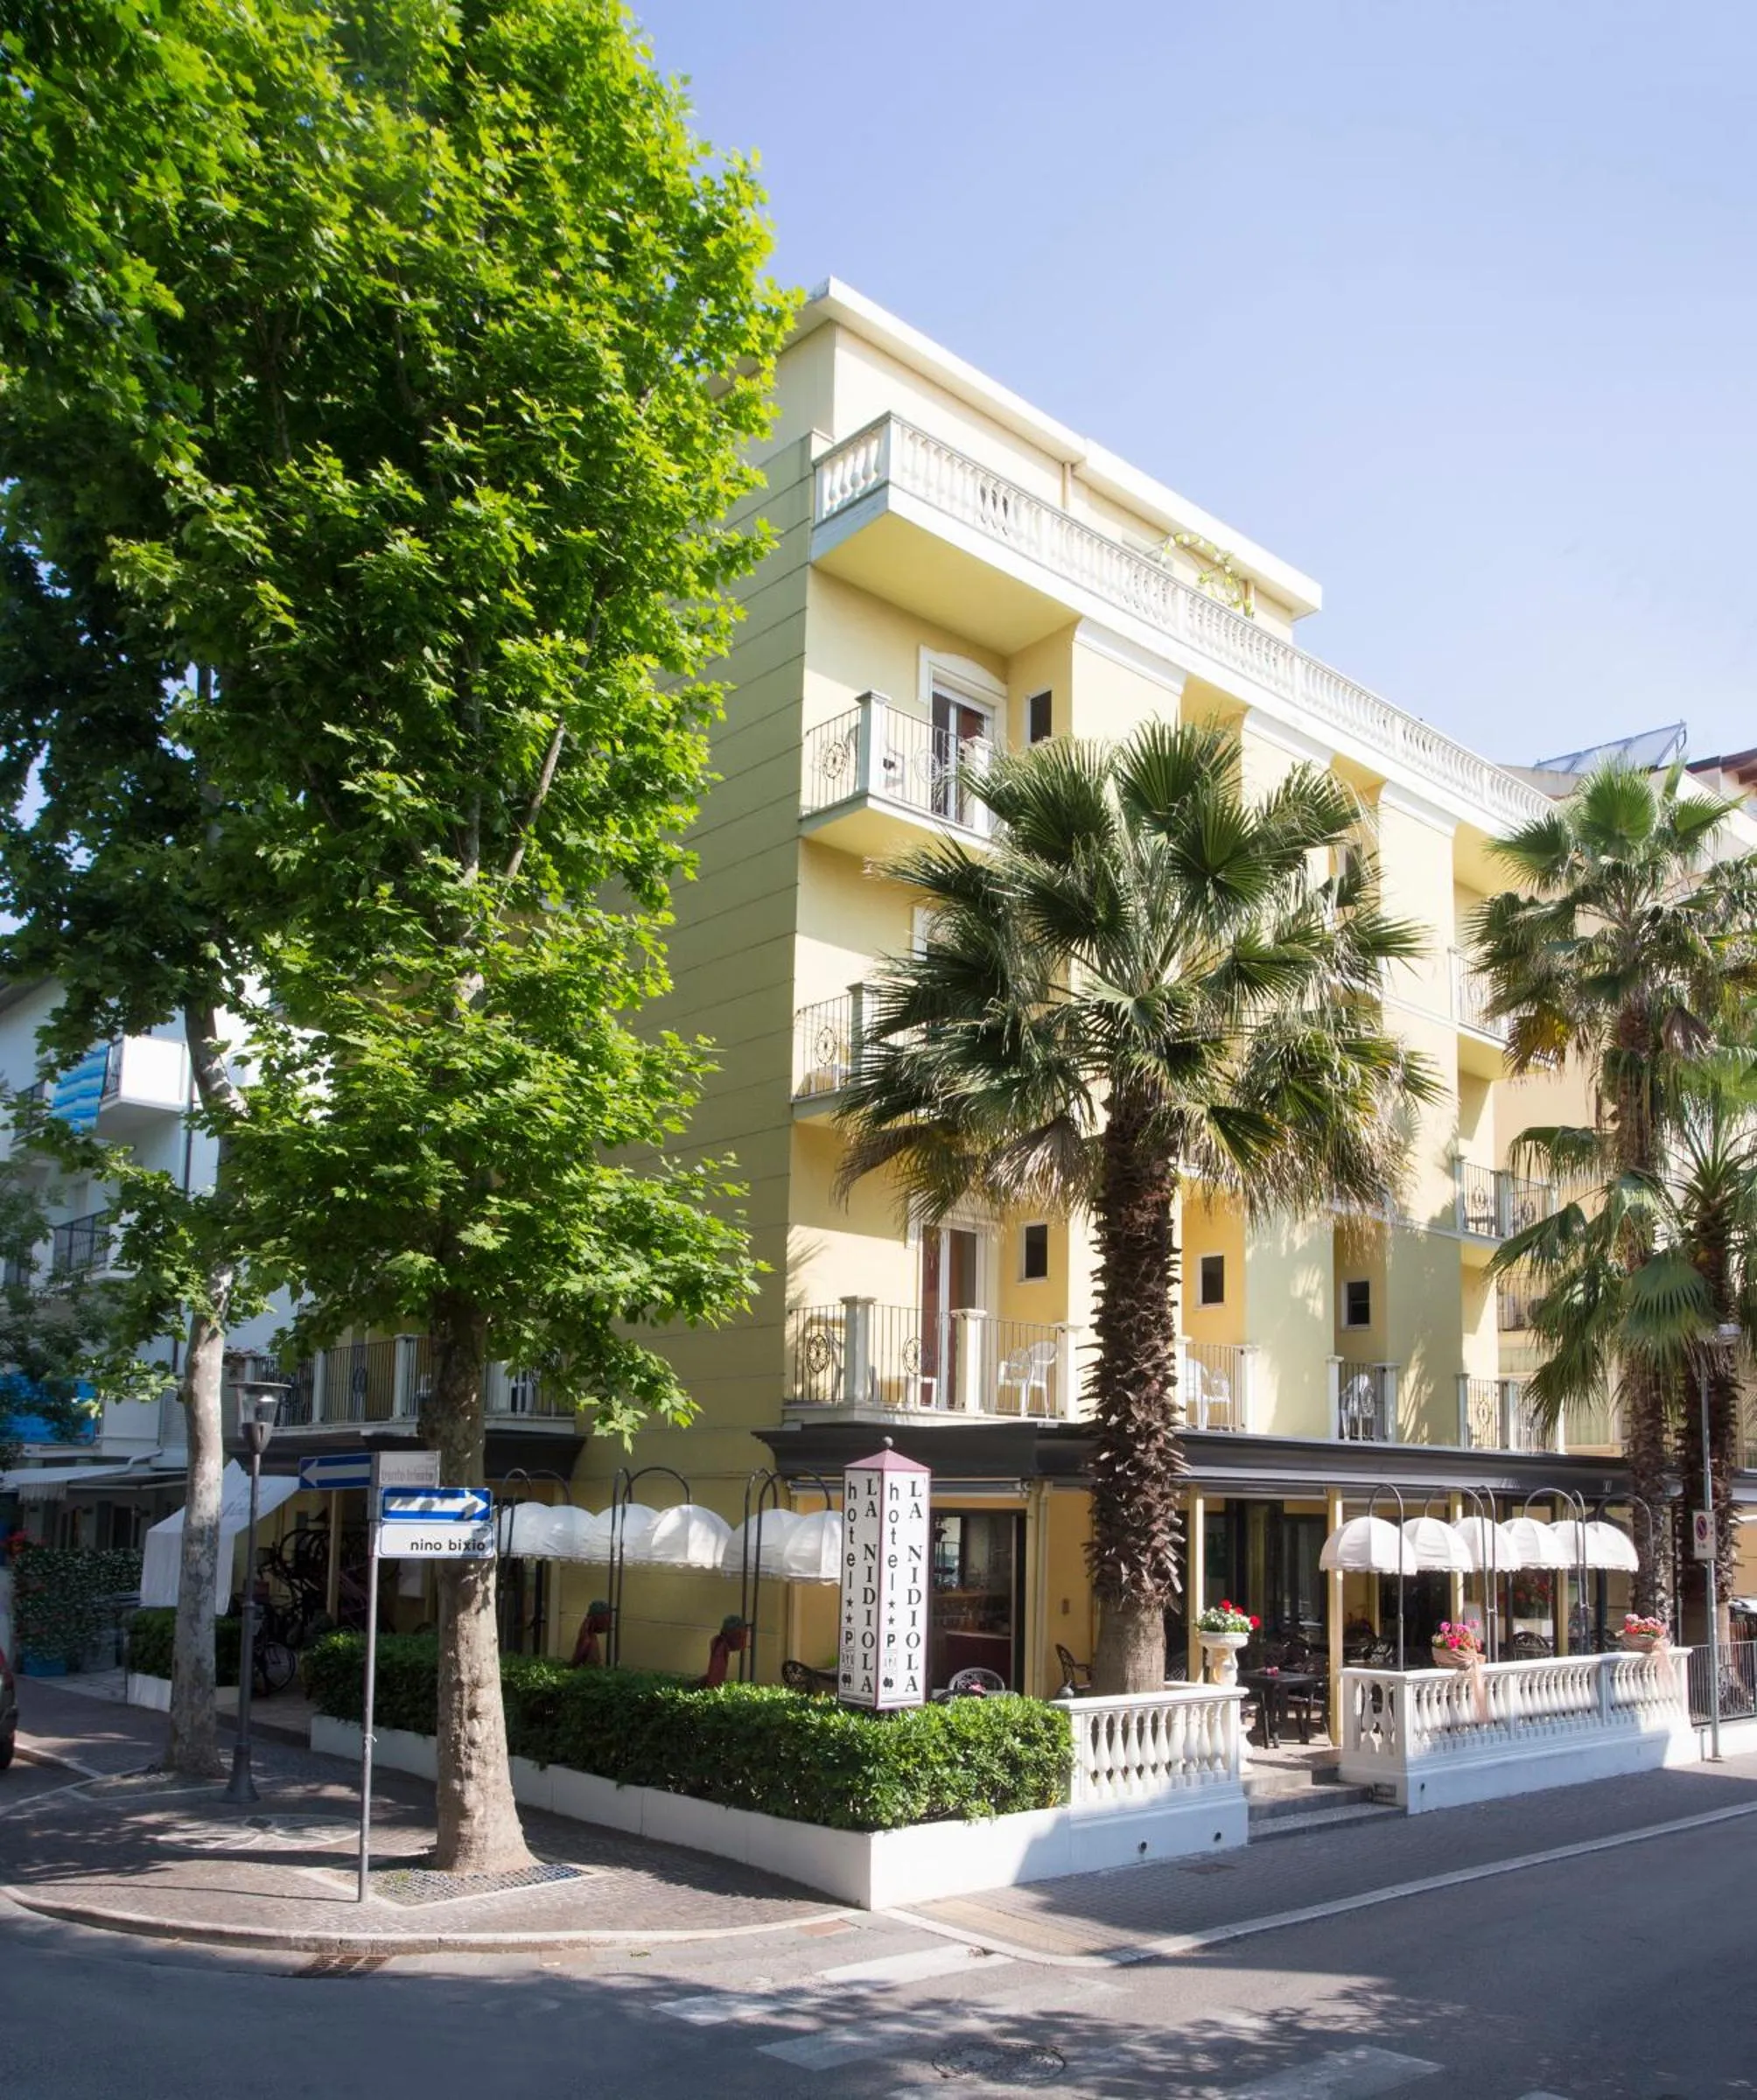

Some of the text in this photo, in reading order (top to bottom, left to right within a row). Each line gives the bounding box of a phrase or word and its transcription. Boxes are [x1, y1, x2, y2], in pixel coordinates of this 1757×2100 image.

[410, 1538, 486, 1550] nino bixio
[846, 1480, 858, 1590] hotel
[860, 1478, 878, 1693] LA NIDIOLA
[887, 1481, 900, 1591] hotel
[905, 1480, 923, 1692] LA NIDIOLA
